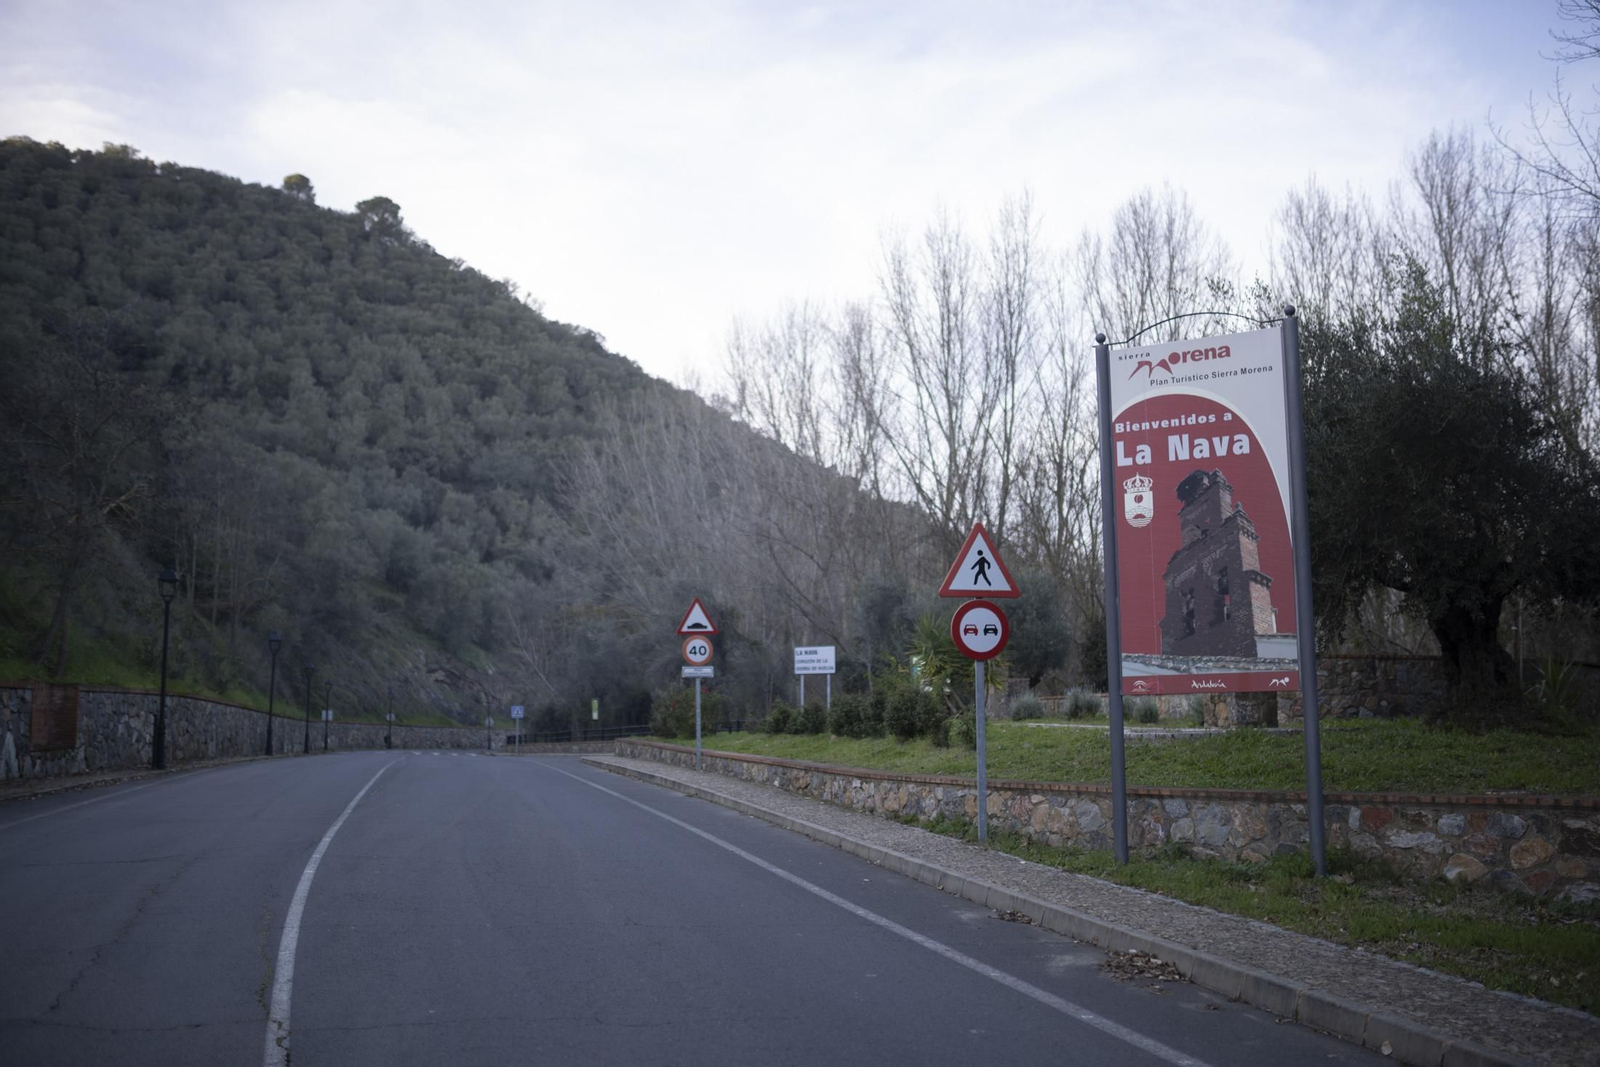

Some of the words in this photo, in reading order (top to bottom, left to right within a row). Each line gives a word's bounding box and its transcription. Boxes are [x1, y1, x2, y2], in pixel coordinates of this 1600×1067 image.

[1118, 352, 1150, 361] sierra
[1150, 378, 1169, 387] Plan
[1211, 370, 1238, 379] Sierra
[1240, 365, 1273, 375] Morena
[1115, 413, 1216, 433] Bienvenidos
[1223, 412, 1233, 421] a
[1116, 441, 1152, 467] La
[1167, 433, 1251, 461] Nava
[689, 645, 707, 656] 40
